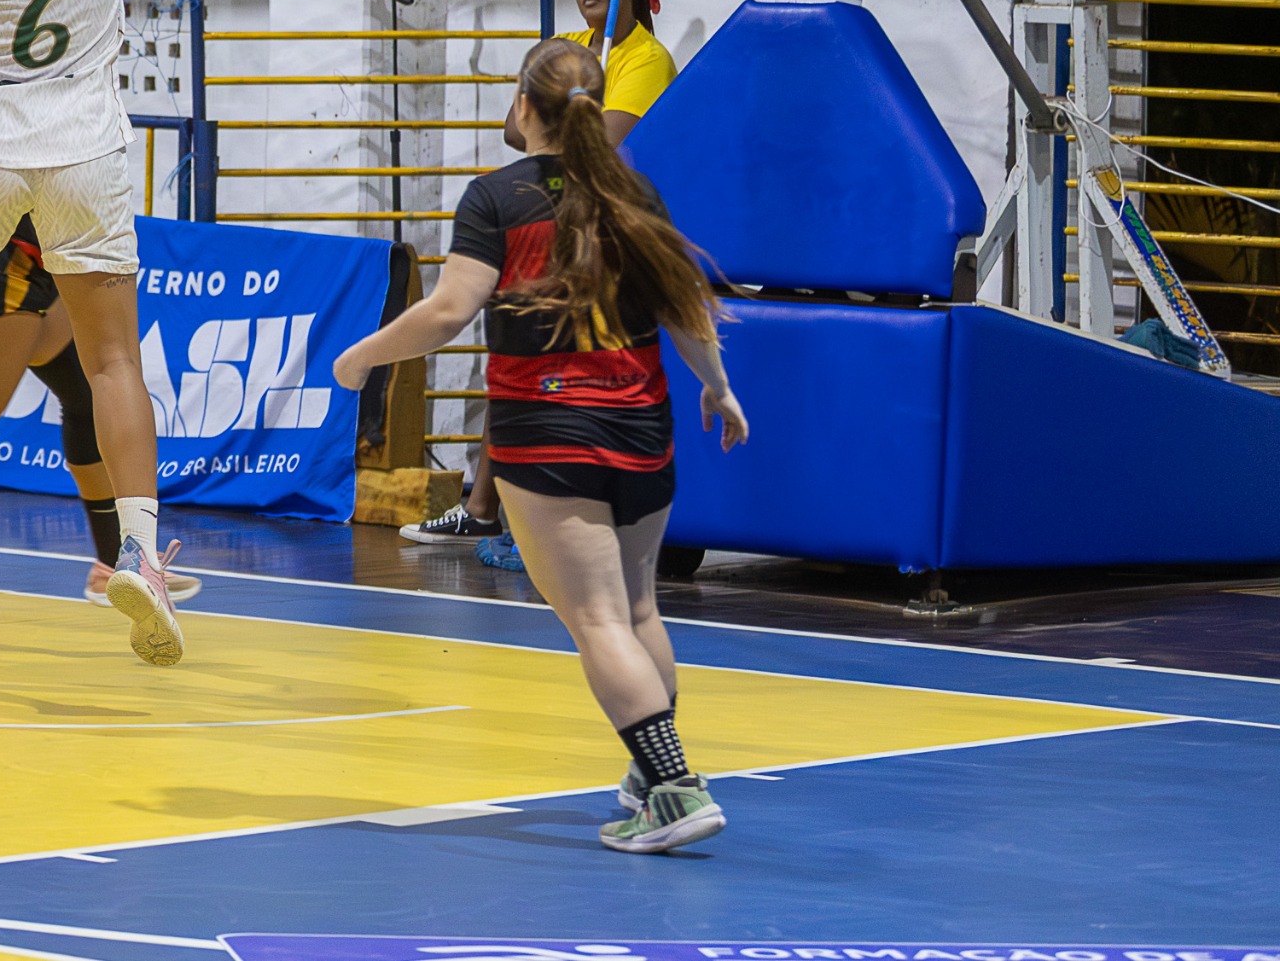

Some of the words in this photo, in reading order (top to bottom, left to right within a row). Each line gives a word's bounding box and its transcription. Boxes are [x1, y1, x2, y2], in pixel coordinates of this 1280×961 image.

[136, 268, 226, 297] VERNO
[243, 269, 279, 296] DO
[179, 453, 301, 476] BRASILEIRO
